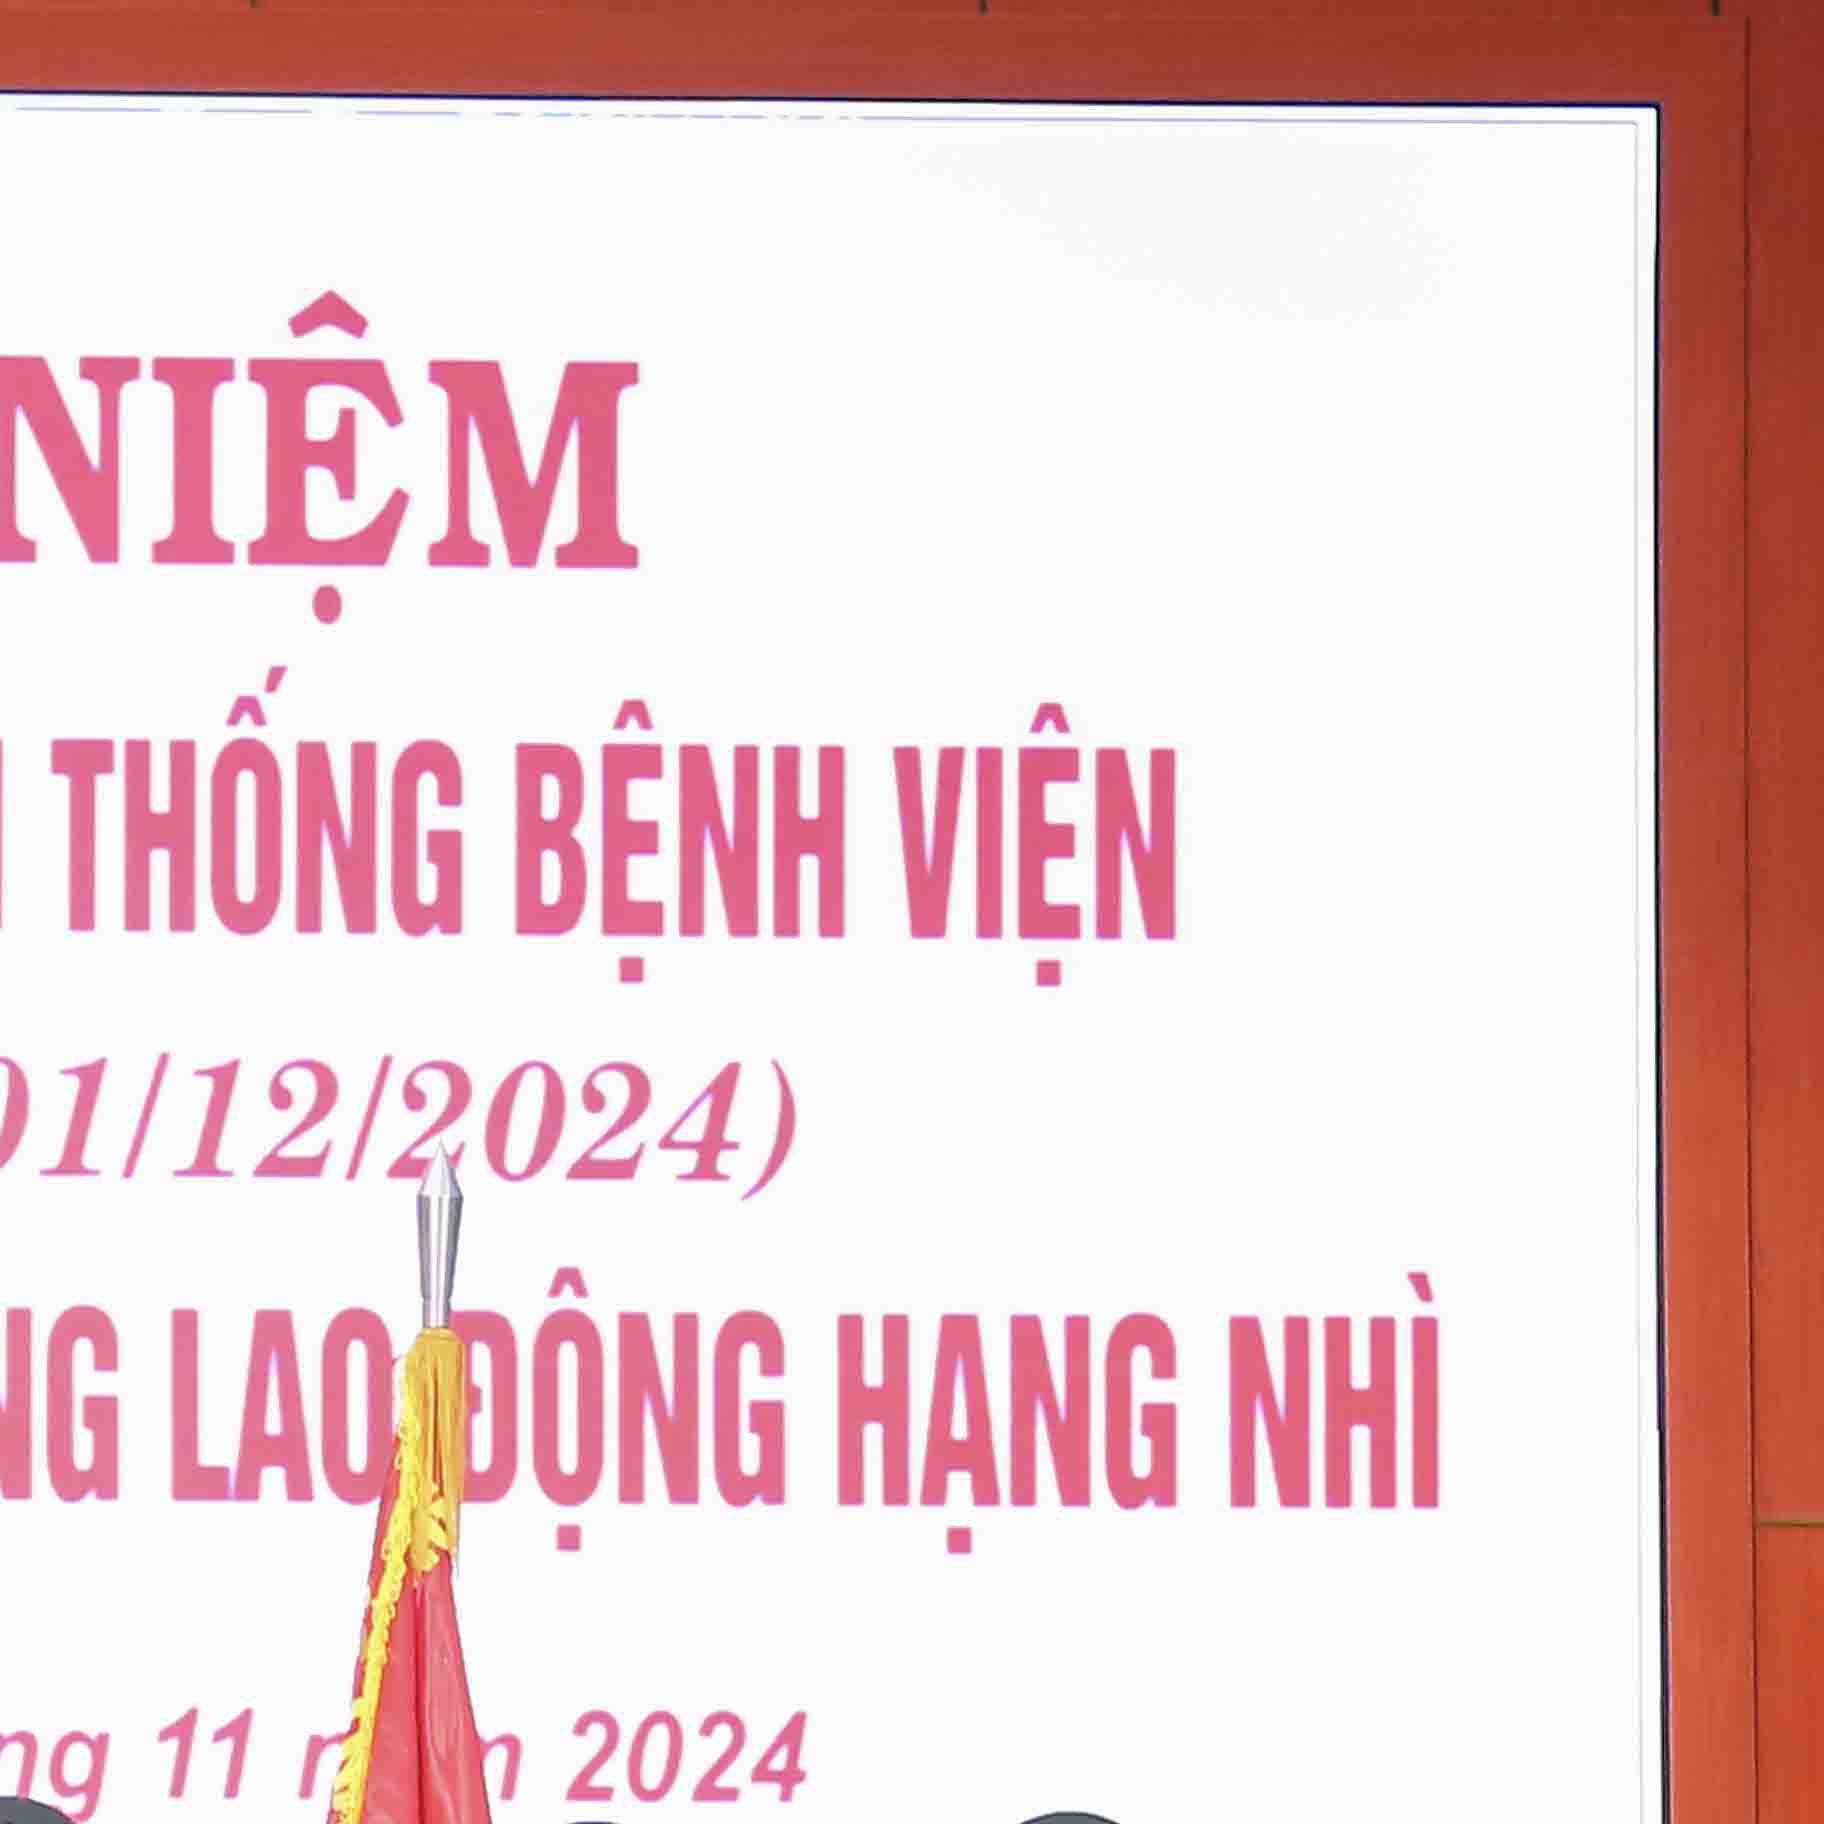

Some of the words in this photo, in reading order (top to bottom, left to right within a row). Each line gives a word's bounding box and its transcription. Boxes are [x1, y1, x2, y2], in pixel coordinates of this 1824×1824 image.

[49, 666, 464, 937] THỐNG
[515, 699, 846, 983] BỆNH
[895, 703, 1177, 987] VIỆN
[171, 1305, 394, 1505] LAO
[449, 1267, 785, 1552] ĐỘNG
[837, 1312, 1177, 1553] HẠNG
[1228, 1271, 1440, 1509] NHÌ
[160, 1707, 253, 1799] 11
[566, 1711, 807, 1803] 2024
